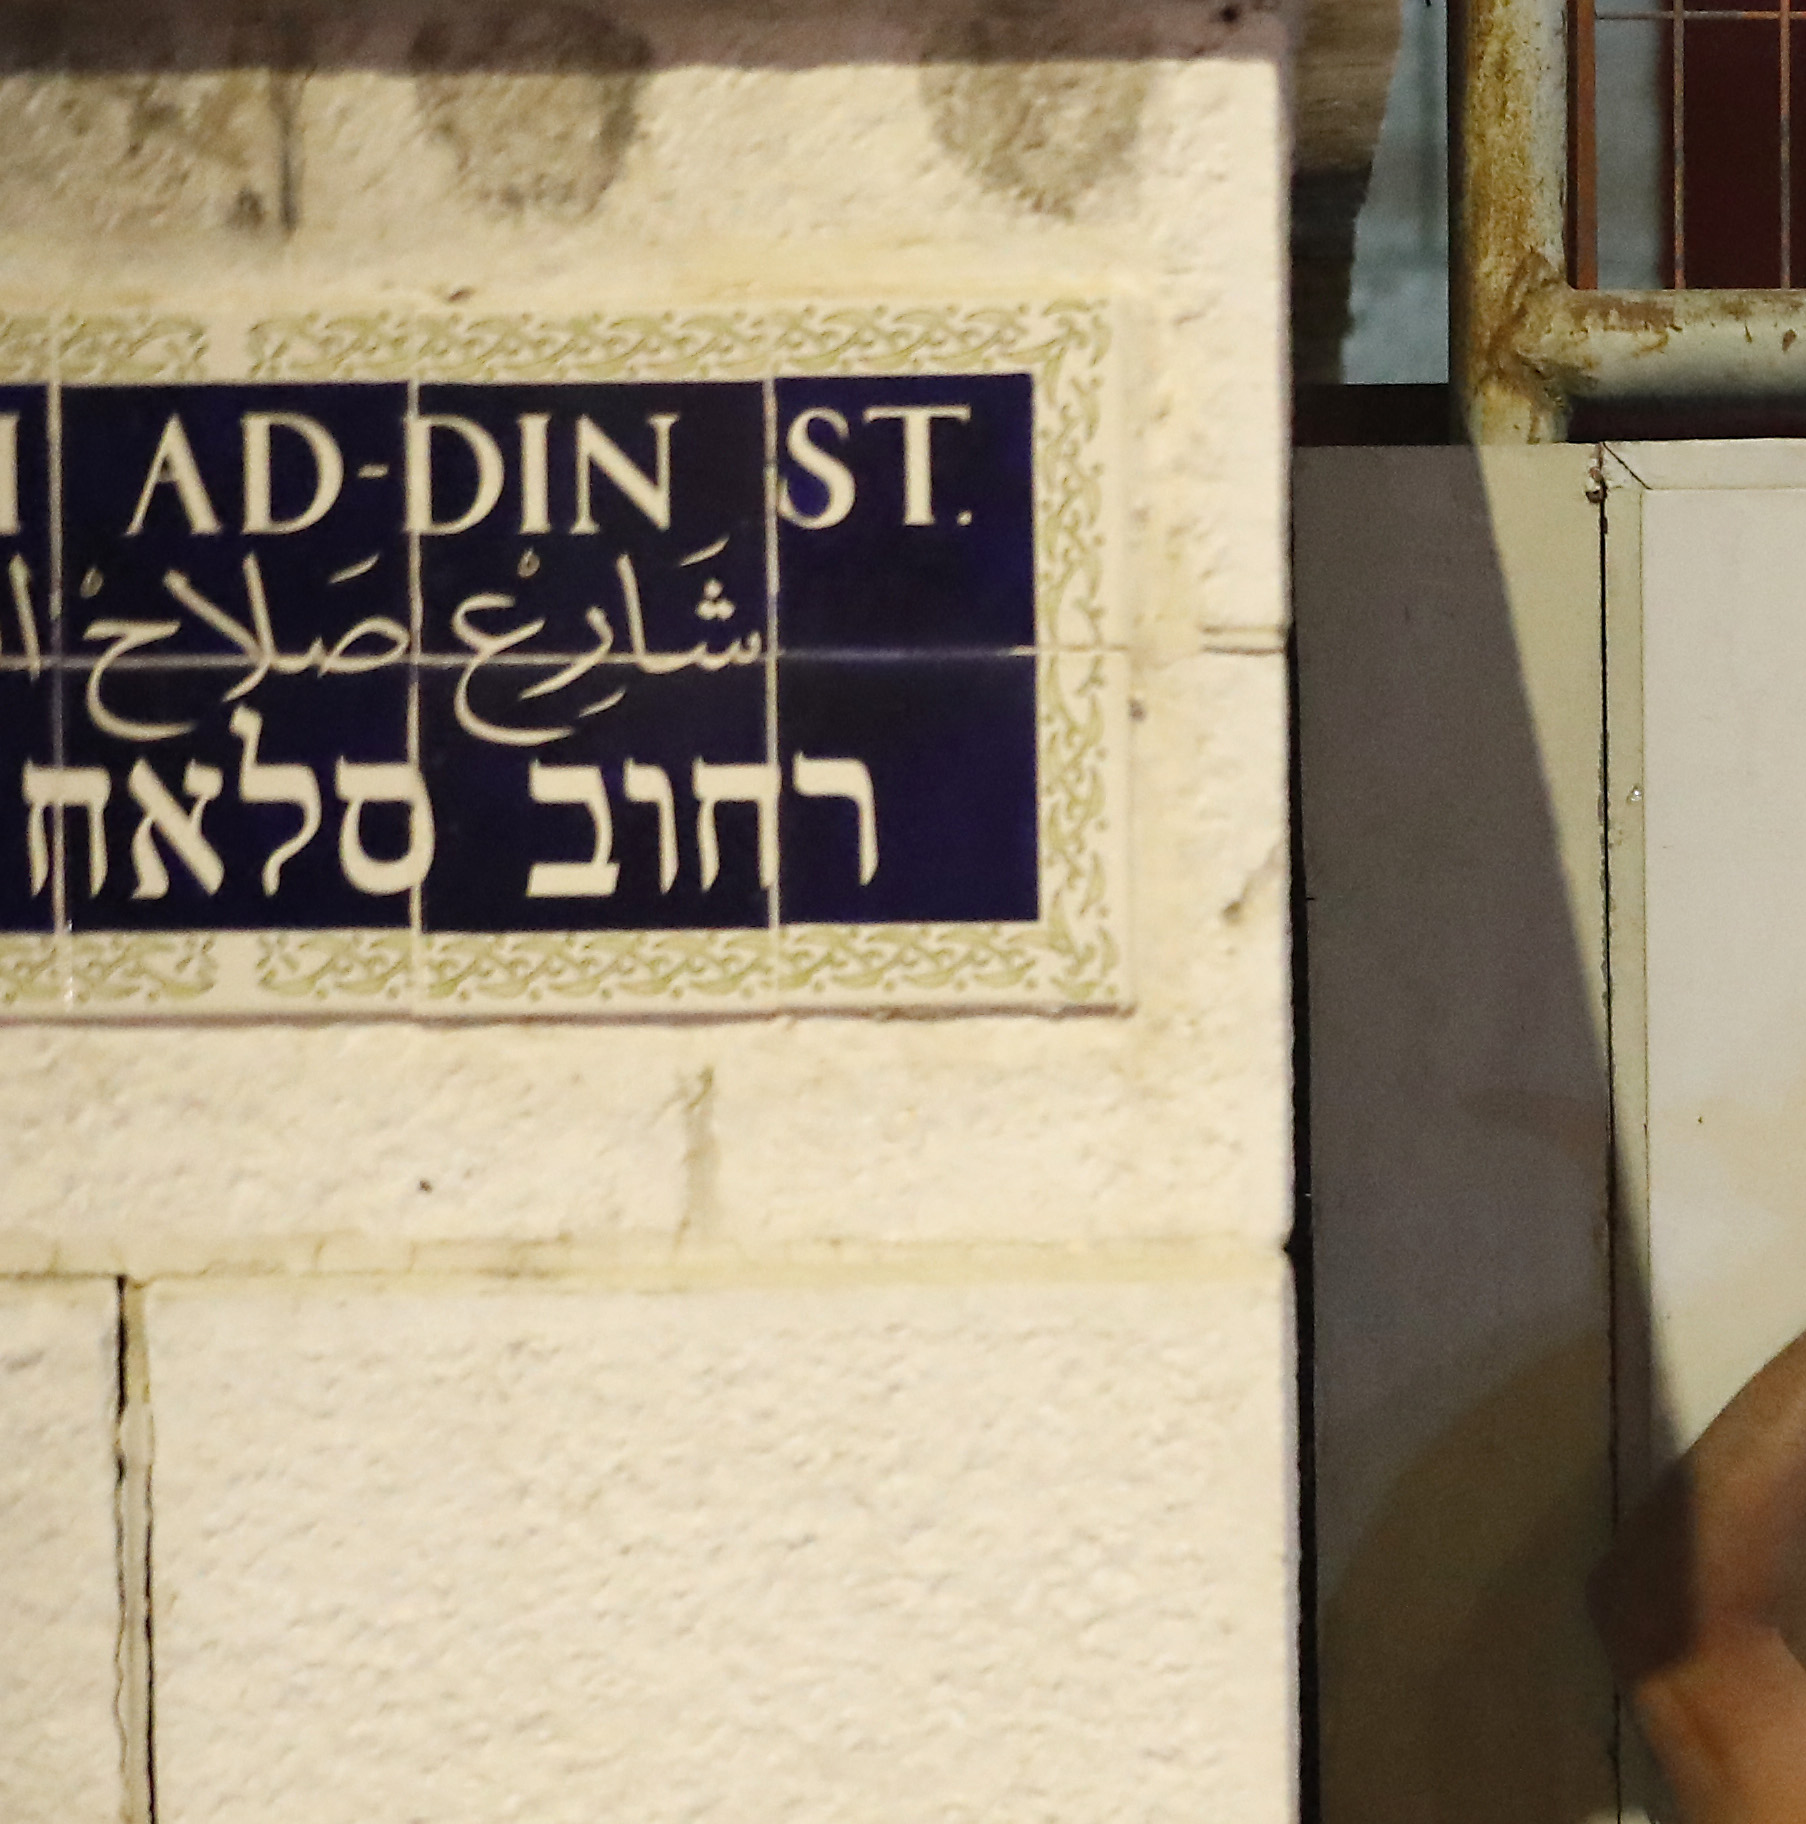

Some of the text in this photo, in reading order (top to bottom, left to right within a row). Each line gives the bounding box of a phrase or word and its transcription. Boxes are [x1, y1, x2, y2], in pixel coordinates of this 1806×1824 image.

[126, 411, 678, 537] AD-DIN
[776, 404, 974, 531] ST.
[21, 703, 880, 898] רחוב סלאח
